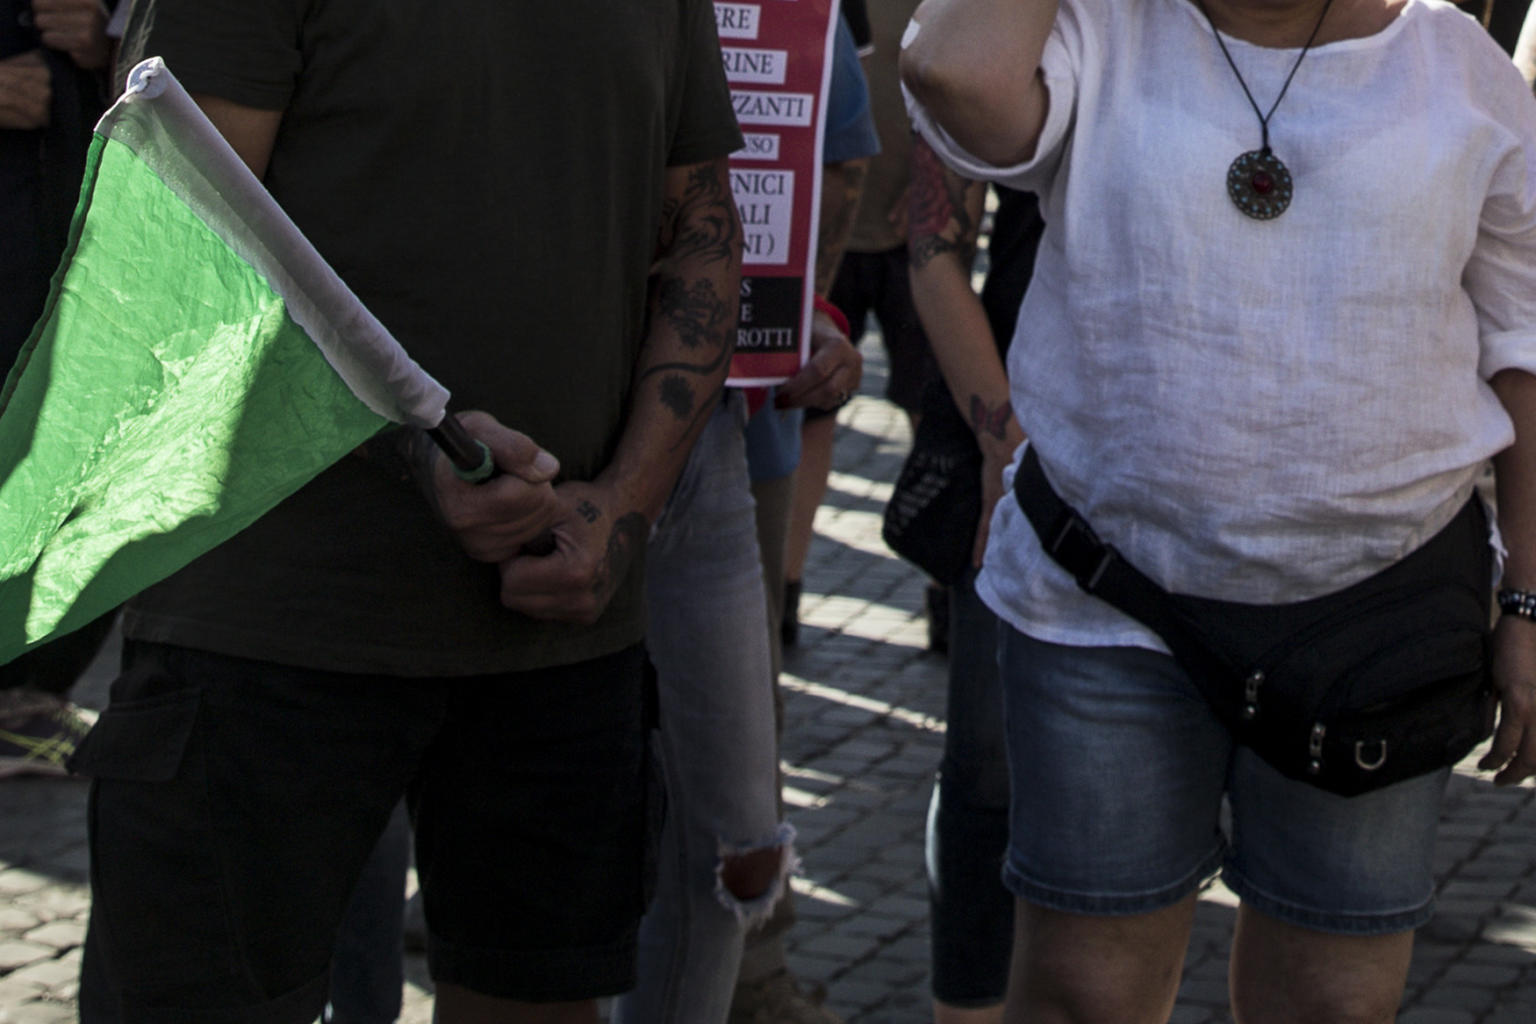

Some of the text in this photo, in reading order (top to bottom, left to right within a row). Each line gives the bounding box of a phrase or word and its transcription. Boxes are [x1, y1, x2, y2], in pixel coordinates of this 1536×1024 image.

[715, 6, 751, 30] RE
[730, 173, 785, 195] NICI
[741, 303, 753, 322] E
[736, 327, 792, 347] ROTTI
